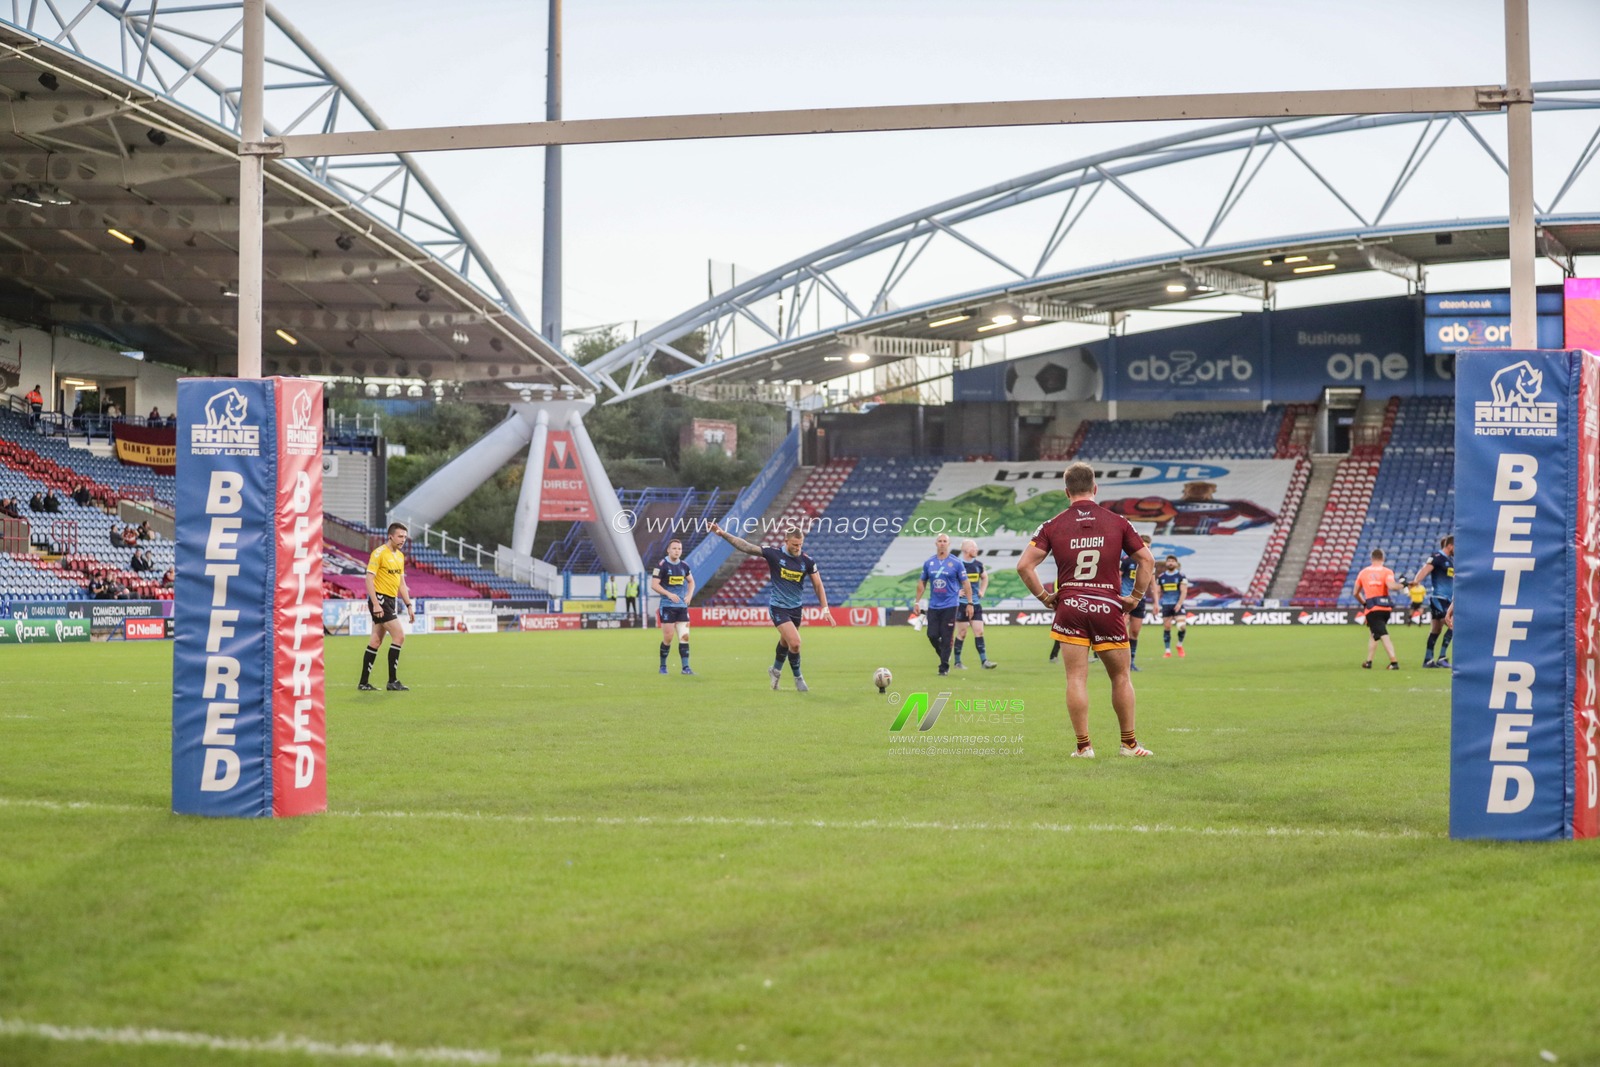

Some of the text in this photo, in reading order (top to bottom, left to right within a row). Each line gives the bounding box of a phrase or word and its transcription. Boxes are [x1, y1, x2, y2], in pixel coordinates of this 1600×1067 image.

[1298, 331, 1361, 345] Business
[1327, 353, 1408, 380] one
[1475, 407, 1557, 422] RHINO
[191, 429, 259, 443] RHINO
[287, 430, 317, 444] RHINO
[1475, 428, 1557, 437] RUGBY LEAGUE
[123, 442, 151, 454] GIANTS
[225, 448, 260, 456] LEAGUE
[543, 480, 583, 490] DIRECT
[1070, 536, 1104, 550] CLOUGH
[1074, 549, 1100, 580] 8
[31, 606, 66, 616] 01484 401 000
[93, 606, 151, 616] COMMERCIAL PROPERTY
[1027, 612, 1056, 624] JAS
[1196, 612, 1234, 625] JASIC
[1252, 612, 1291, 624] JASIC
[1309, 612, 1348, 624] JASIC
[200, 471, 244, 791] BETFRED
[293, 471, 315, 789] BETFRED
[1486, 453, 1539, 813] BETFRED
